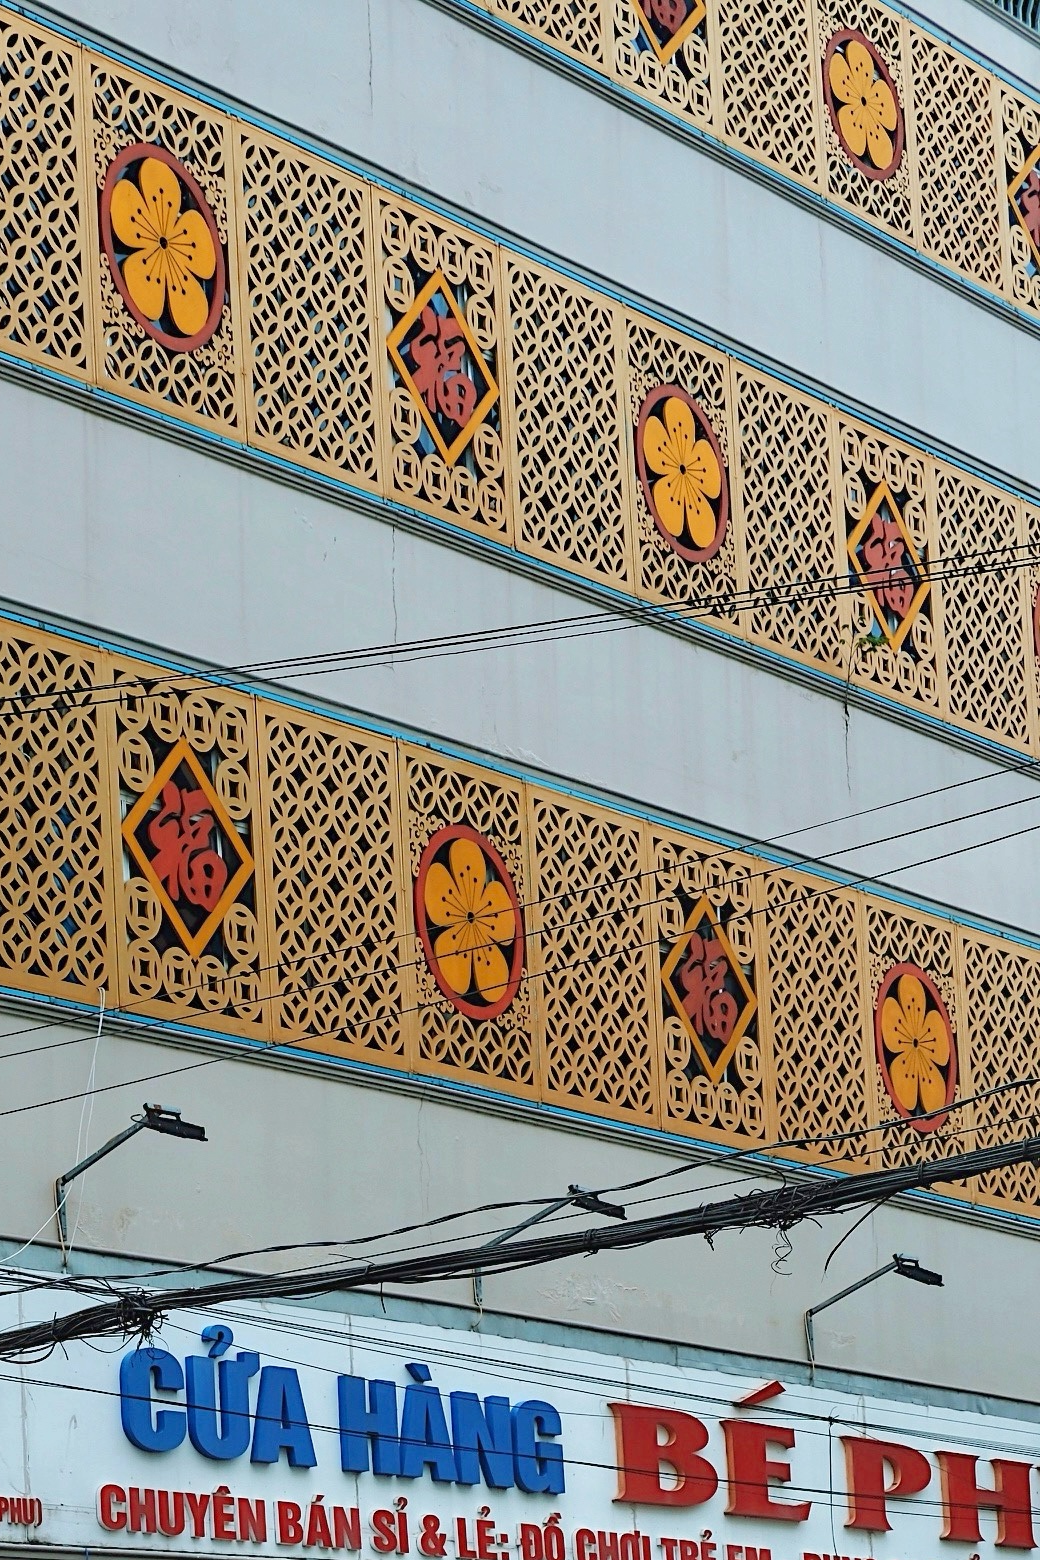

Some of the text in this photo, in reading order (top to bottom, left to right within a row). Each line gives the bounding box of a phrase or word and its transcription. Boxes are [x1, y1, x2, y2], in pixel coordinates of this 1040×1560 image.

[119, 1324, 566, 1496] CỬA HÀNG
[606, 1380, 1040, 1550] BÉ PH
[96, 1484, 266, 1544] CHUYÊN
[274, 1495, 361, 1551] BÁN
[370, 1496, 410, 1555] SỈ
[418, 1514, 448, 1557] &
